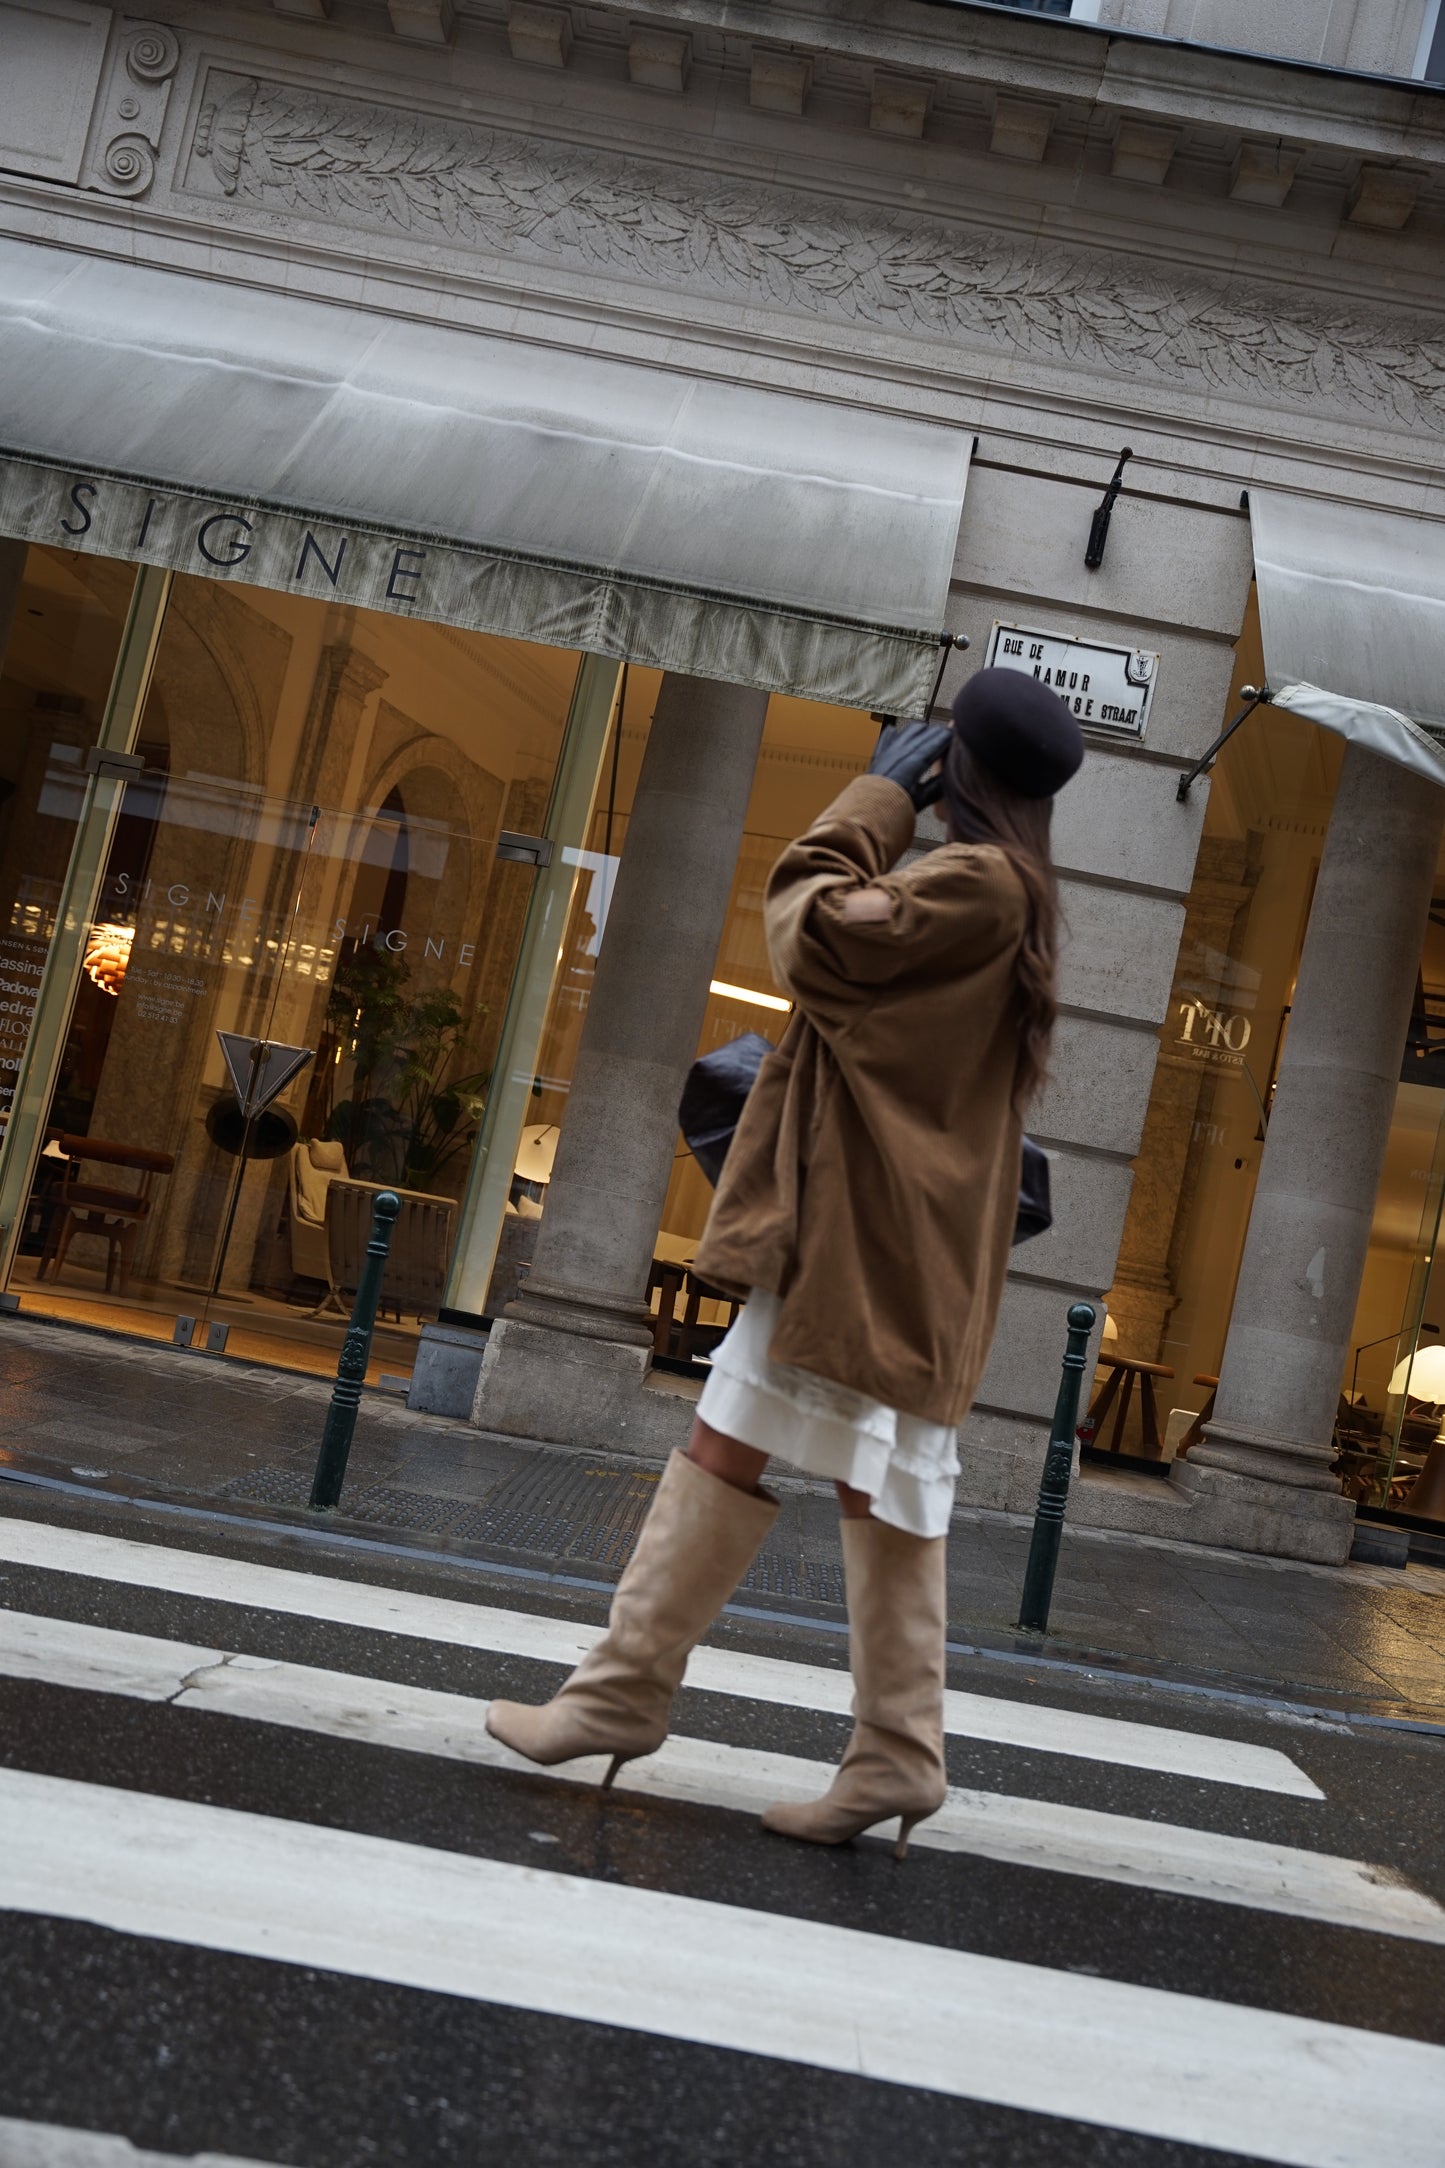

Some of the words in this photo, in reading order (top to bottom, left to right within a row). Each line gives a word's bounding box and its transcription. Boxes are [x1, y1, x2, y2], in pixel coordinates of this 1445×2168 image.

[60, 482, 427, 603] SIGNE
[1003, 638, 1024, 656] RUE
[1029, 643, 1044, 660] DE
[1033, 664, 1090, 692] NAMUR
[1060, 694, 1094, 716] MSE
[1101, 704, 1138, 725] STRAAT
[114, 872, 257, 921] SIGNE
[333, 917, 476, 967] SIGNE
[0, 955, 46, 976] assina
